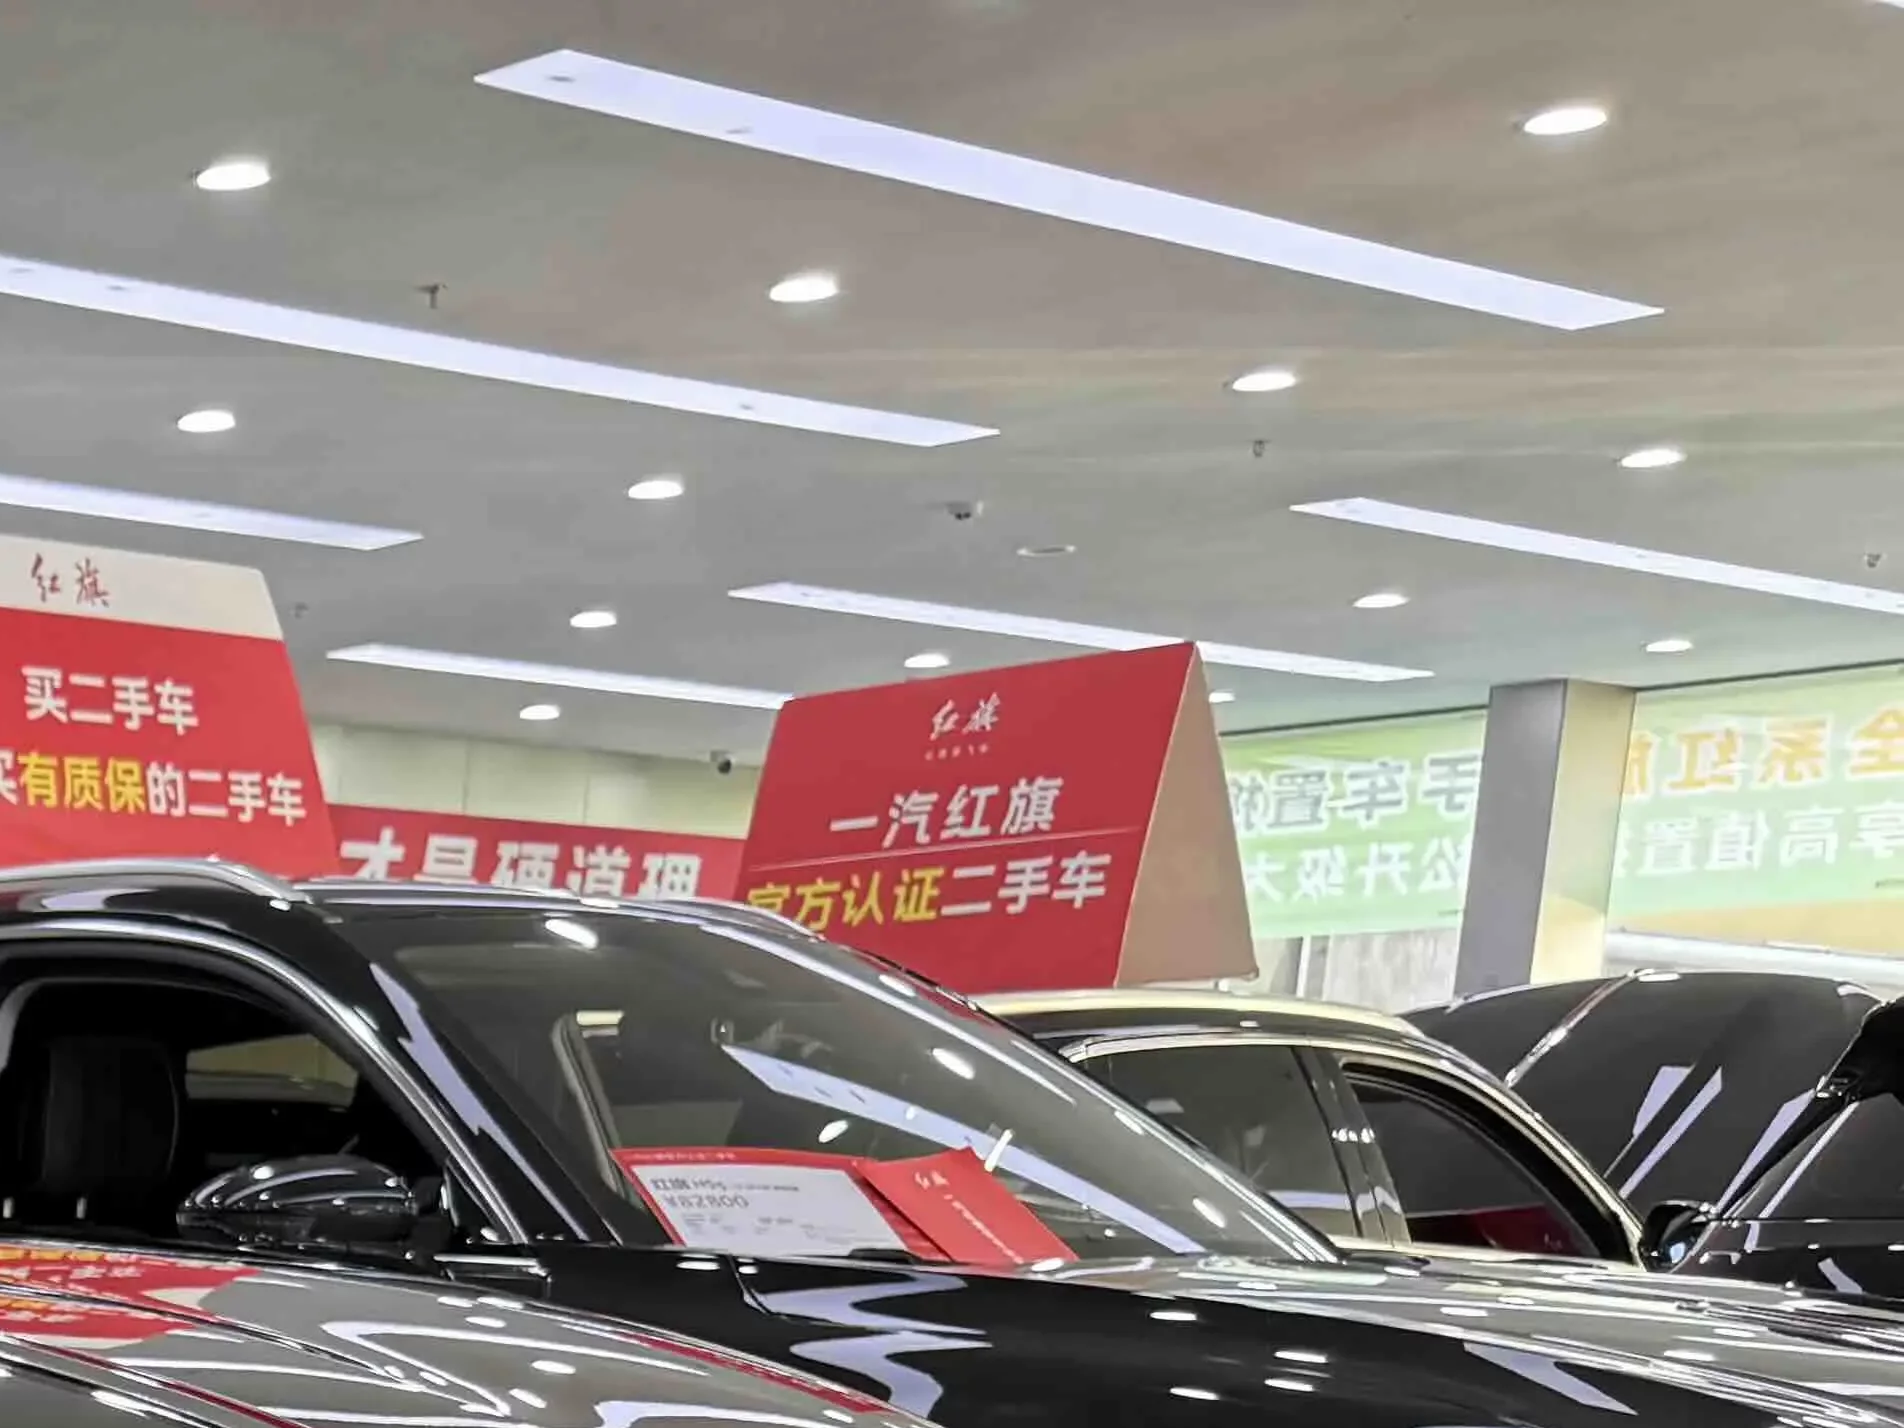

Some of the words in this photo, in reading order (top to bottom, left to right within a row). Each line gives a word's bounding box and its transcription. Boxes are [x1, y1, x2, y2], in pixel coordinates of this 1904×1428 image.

[29, 554, 110, 608] 红旗
[21, 664, 199, 735] 买二手车
[929, 691, 1001, 741] 红旗
[829, 775, 1064, 849] 一汽红旗
[745, 850, 1112, 934] 官方认证二手车
